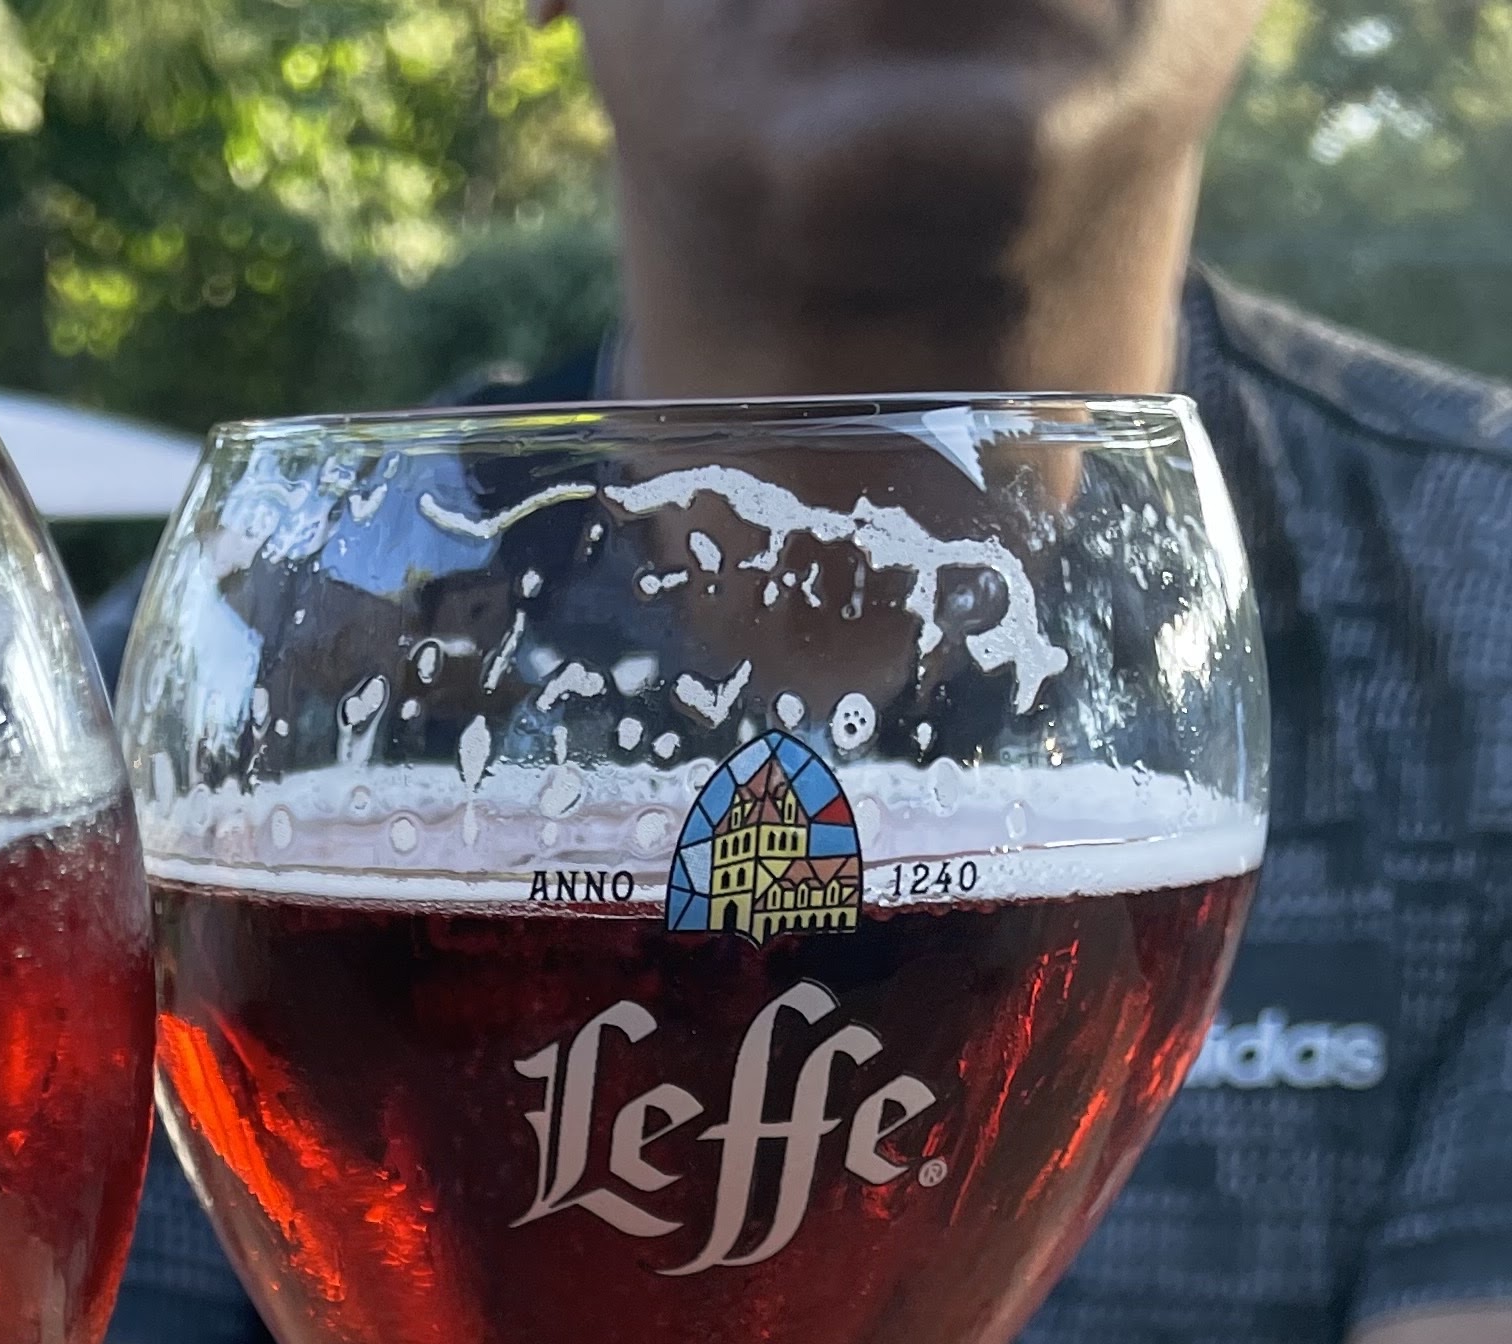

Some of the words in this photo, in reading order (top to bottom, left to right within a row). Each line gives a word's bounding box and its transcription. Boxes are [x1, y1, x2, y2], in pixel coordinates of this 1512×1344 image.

[528, 869, 635, 903] ANNO
[892, 860, 979, 898] 1240
[1185, 1005, 1386, 1090] idas
